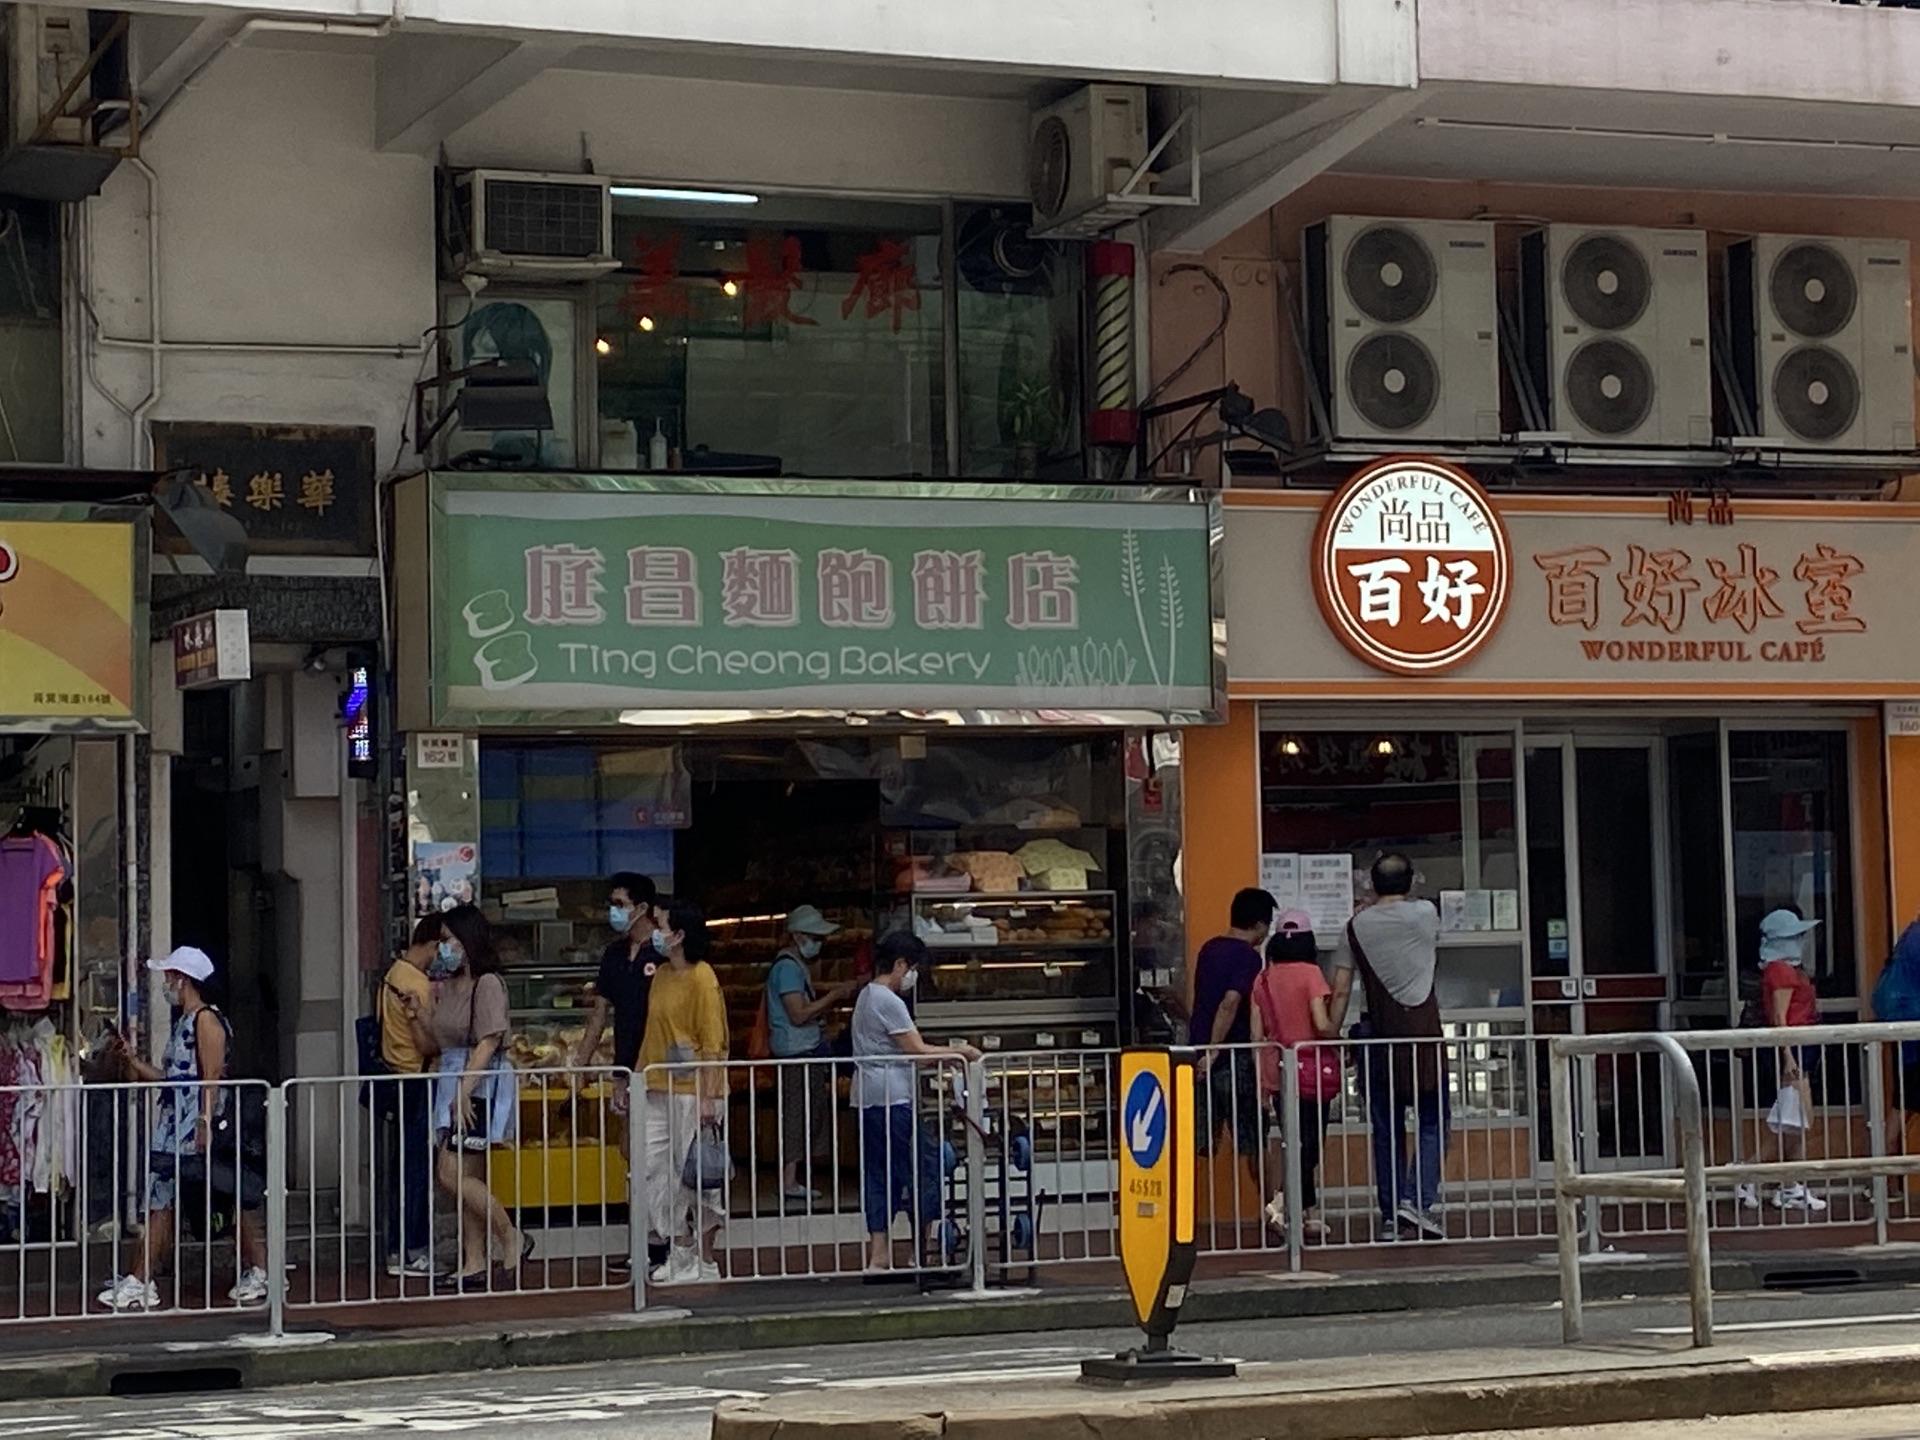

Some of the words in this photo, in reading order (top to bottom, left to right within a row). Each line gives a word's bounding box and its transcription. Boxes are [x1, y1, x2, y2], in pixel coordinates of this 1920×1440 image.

[1338, 475, 1445, 535] WONDERFUL
[1379, 497, 1452, 544] 尚品
[1666, 487, 1735, 526] 尚品
[523, 543, 1080, 630] 庭昌麵飽餅店
[1347, 556, 1486, 630] 百好
[1533, 542, 1866, 635] 百好冰室
[558, 642, 656, 679] Ting
[666, 644, 830, 680] Cheong
[840, 646, 991, 680] Bakery
[1580, 640, 1752, 662] WONDERFUL
[1760, 638, 1826, 663] CAFÉ
